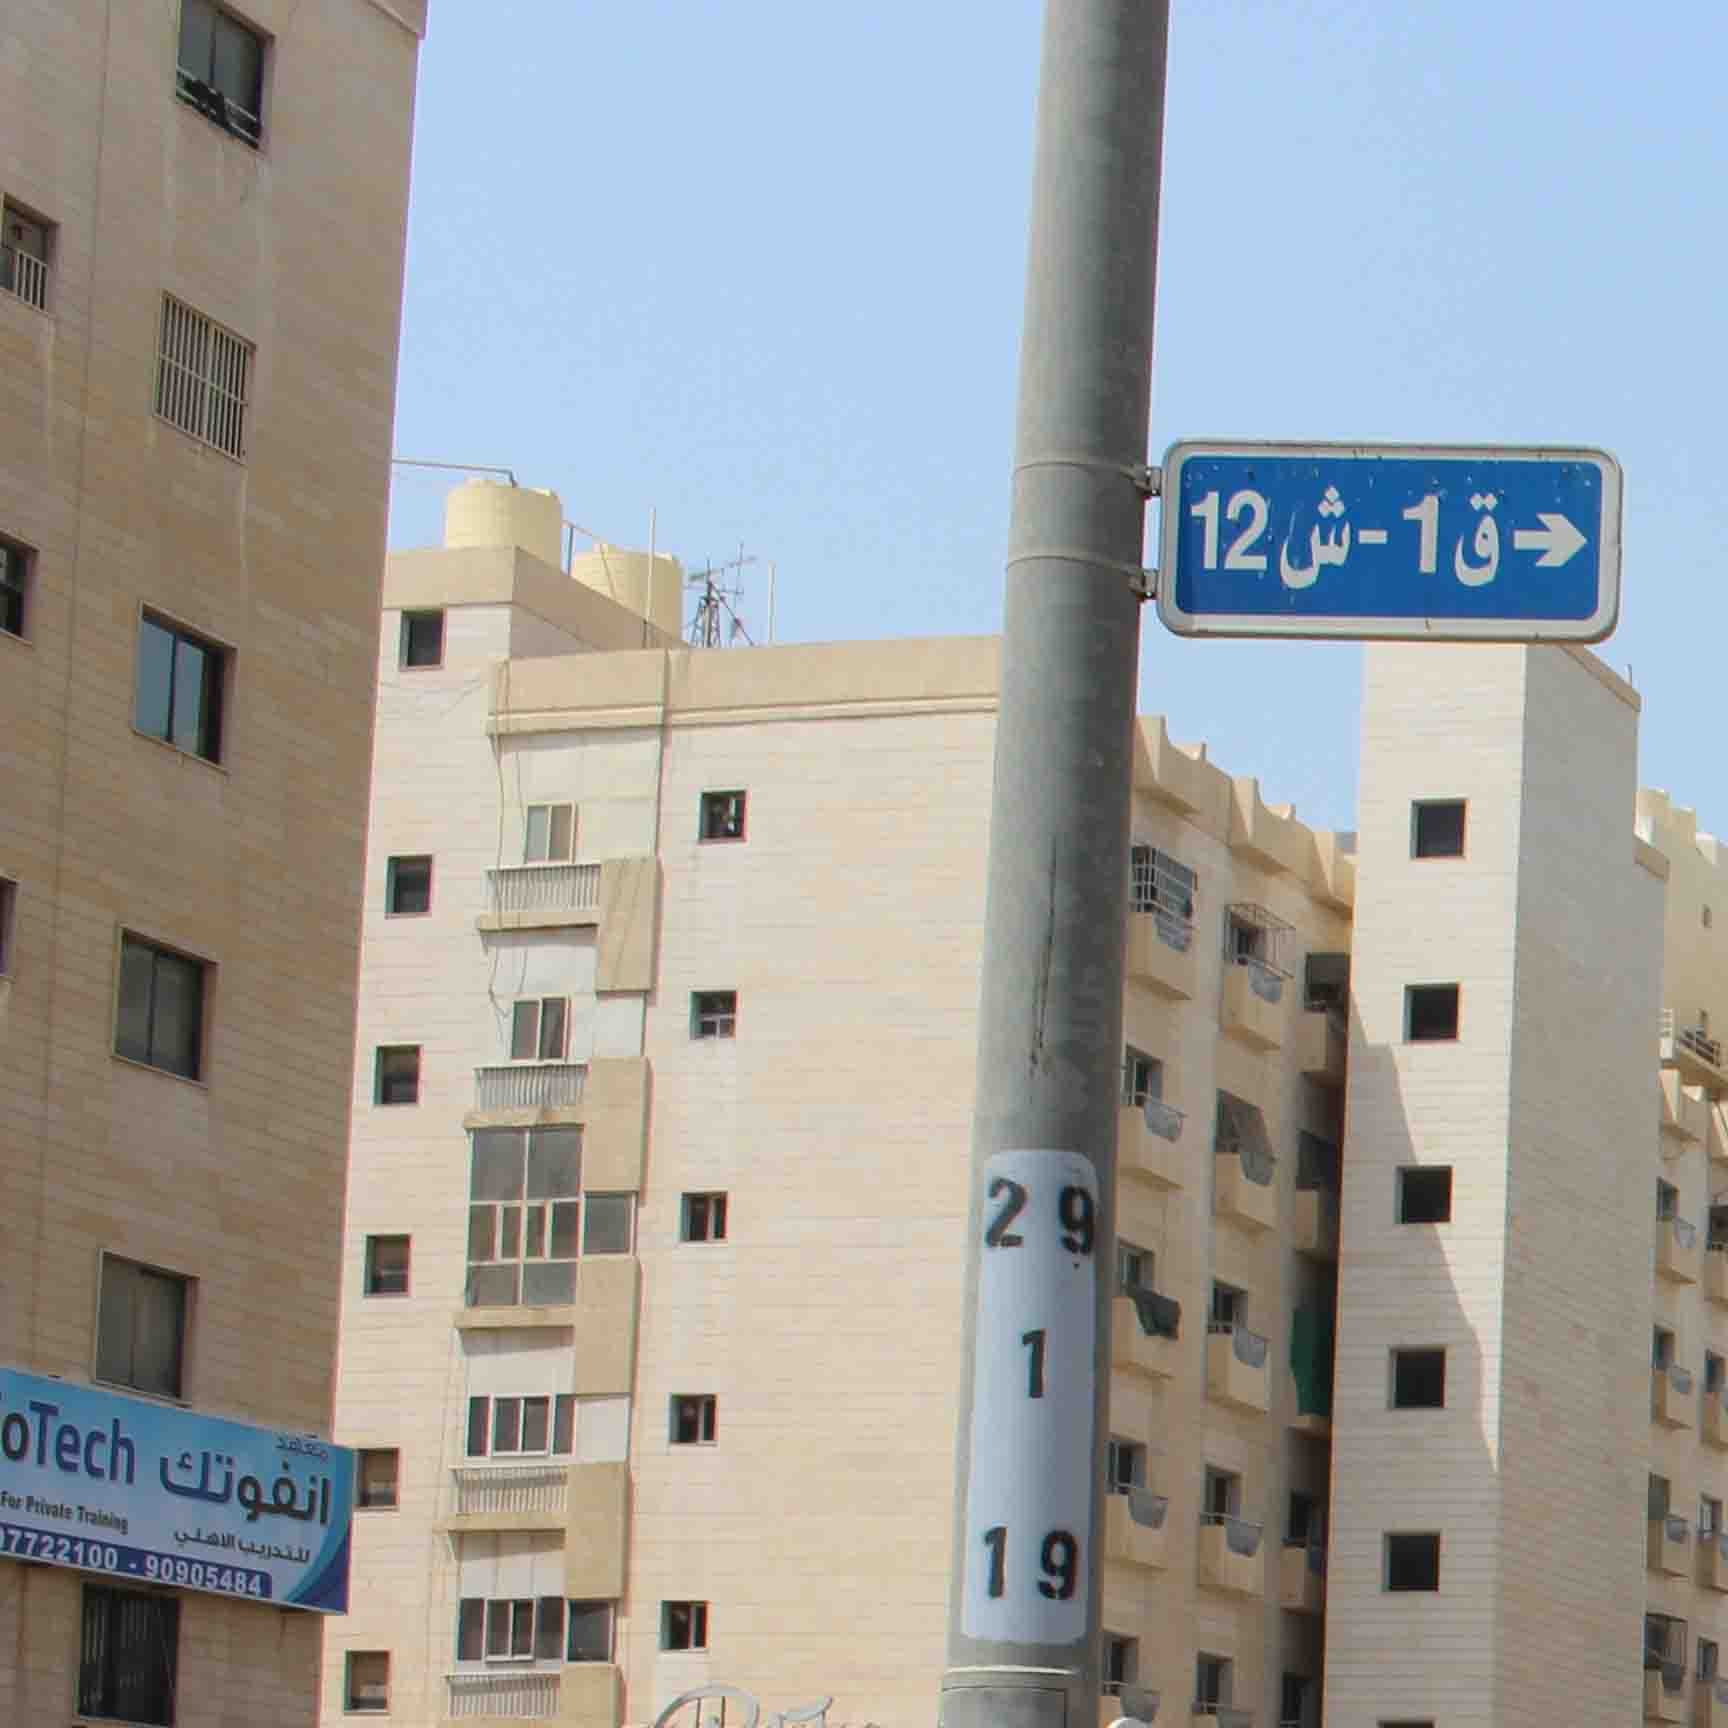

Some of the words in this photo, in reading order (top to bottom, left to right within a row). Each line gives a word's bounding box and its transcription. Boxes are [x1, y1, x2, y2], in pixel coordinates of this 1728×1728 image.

[1021, 1328, 1046, 1398] 1
[0, 1394, 135, 1485] oTech
[26, 1495, 72, 1521] Private
[77, 1504, 129, 1535] Training
[160, 1451, 332, 1525] انفوتك
[145, 1557, 262, 1595] 90905484
